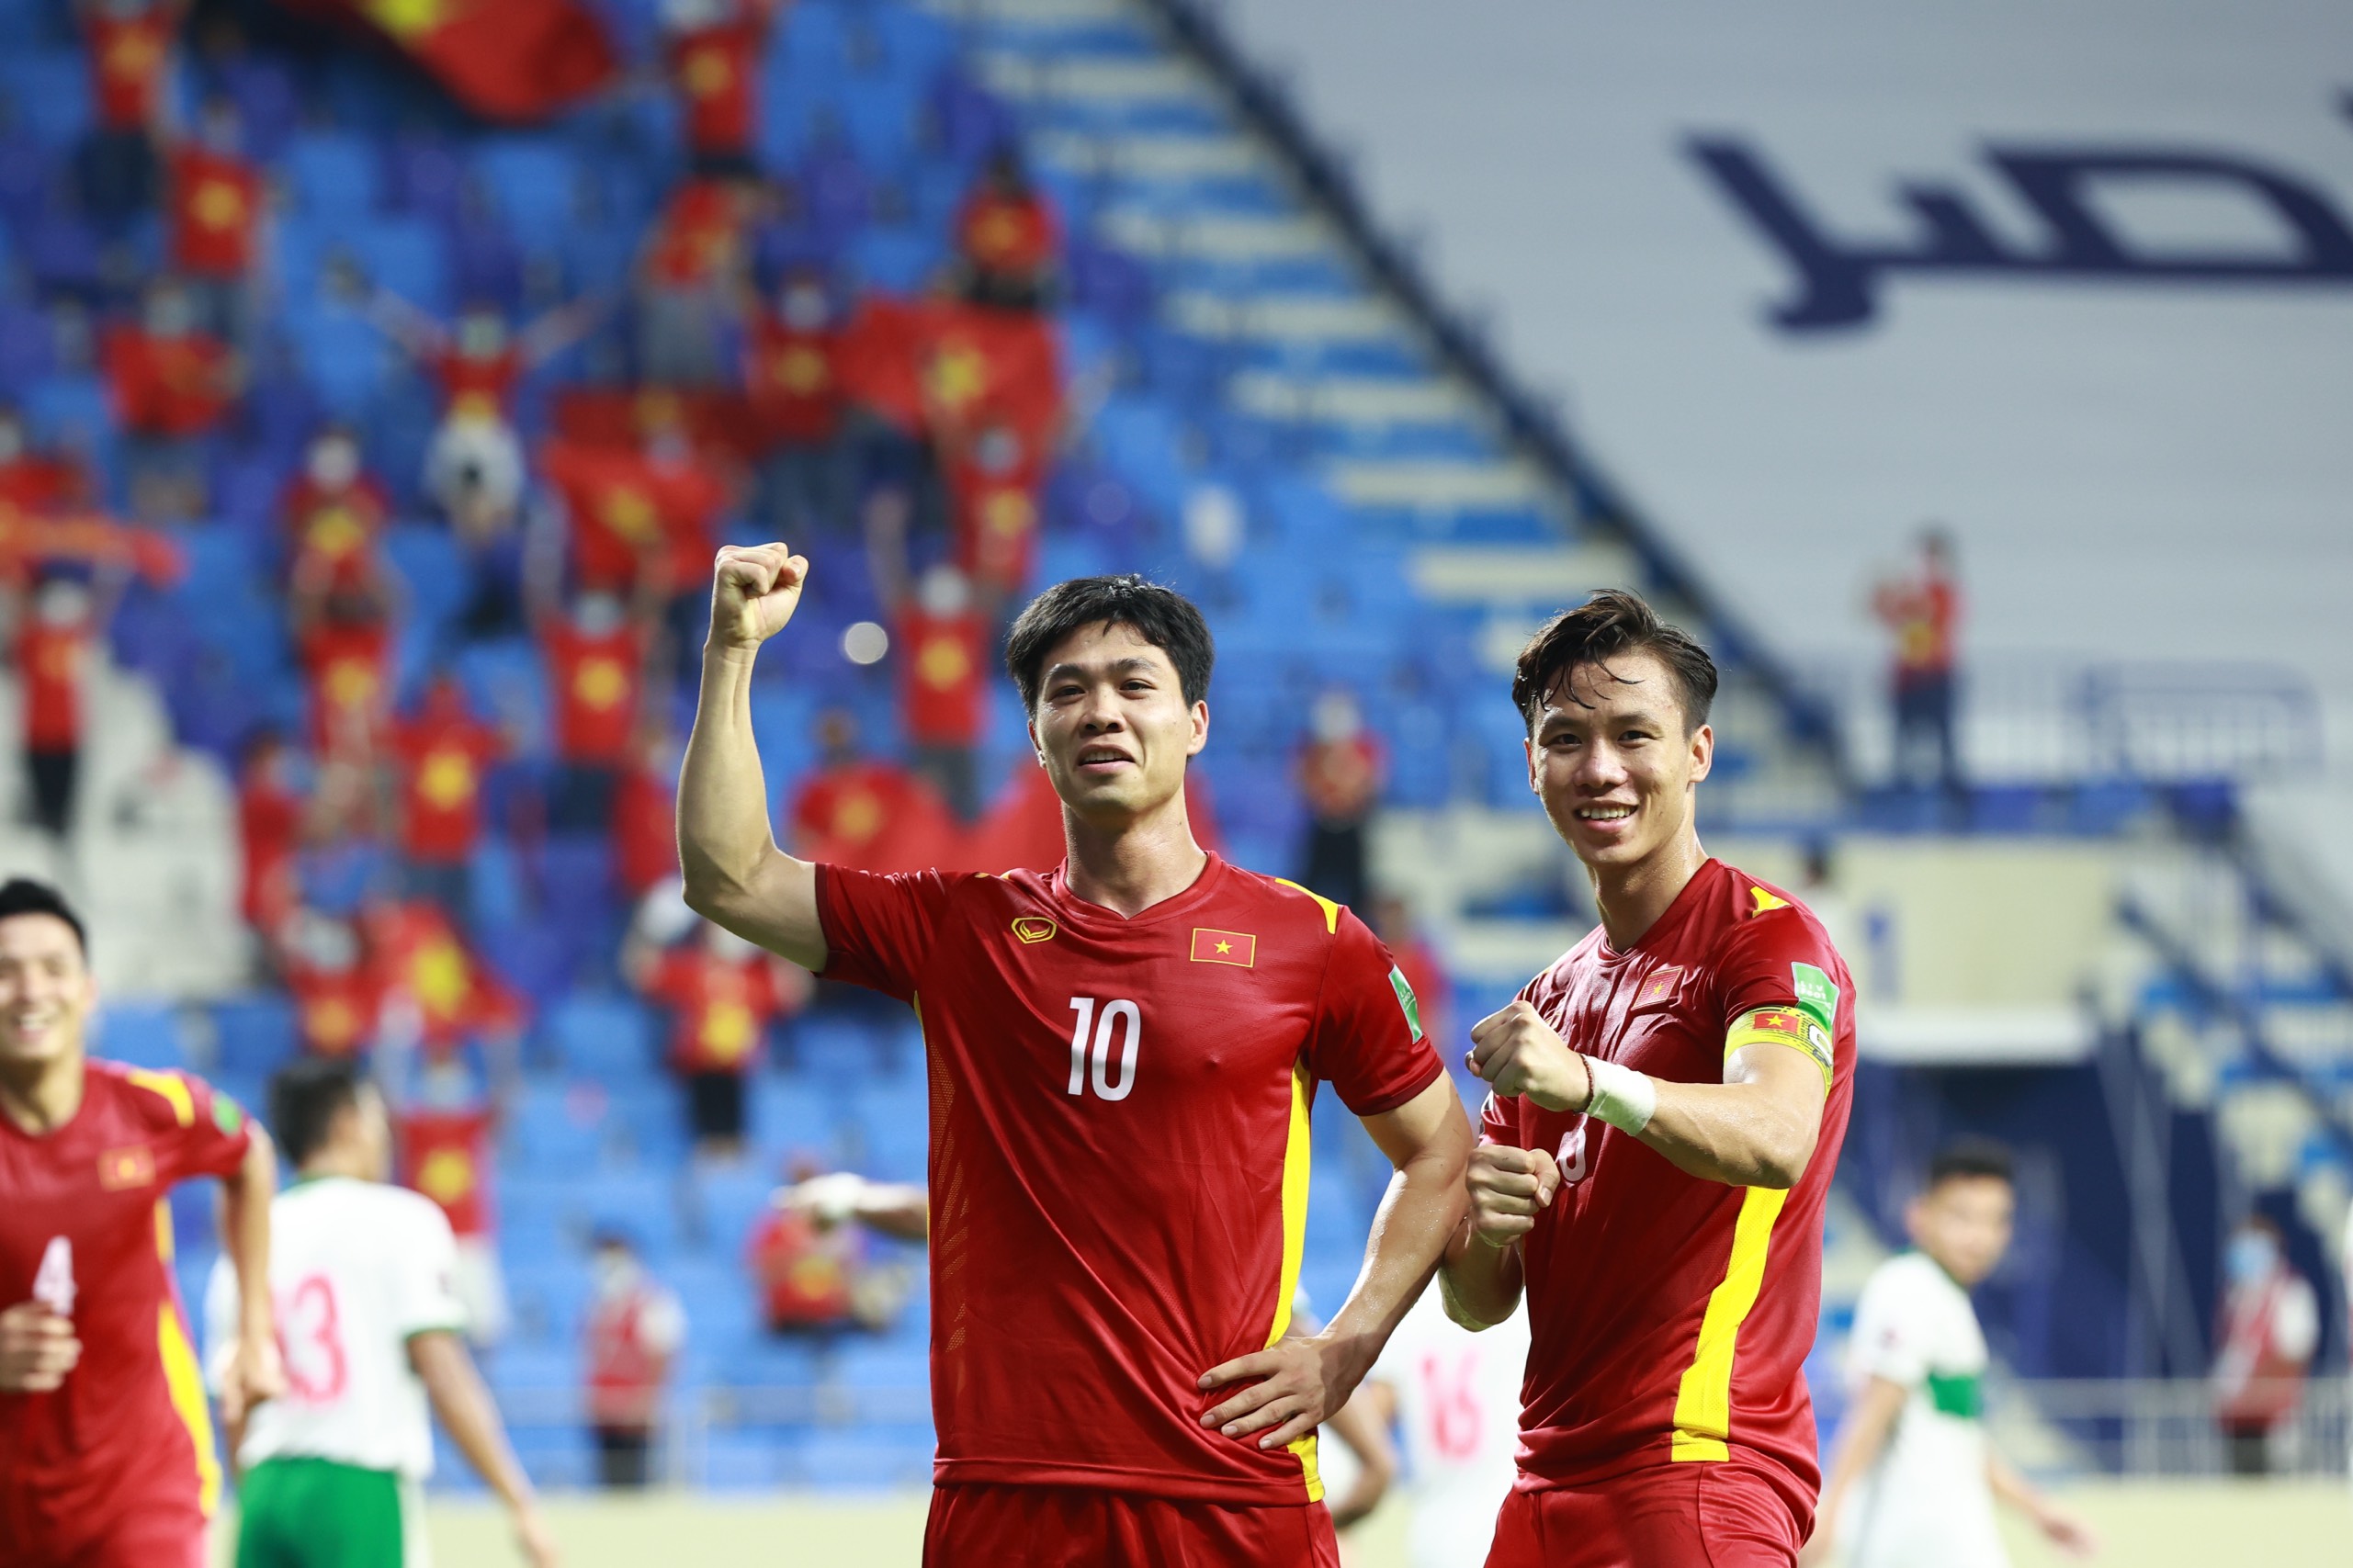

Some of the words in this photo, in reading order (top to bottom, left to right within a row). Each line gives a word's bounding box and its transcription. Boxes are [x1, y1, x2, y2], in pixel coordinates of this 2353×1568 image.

[1674, 88, 2353, 331] صر
[1068, 997, 1141, 1101] 10
[1422, 1349, 1483, 1460] 16
